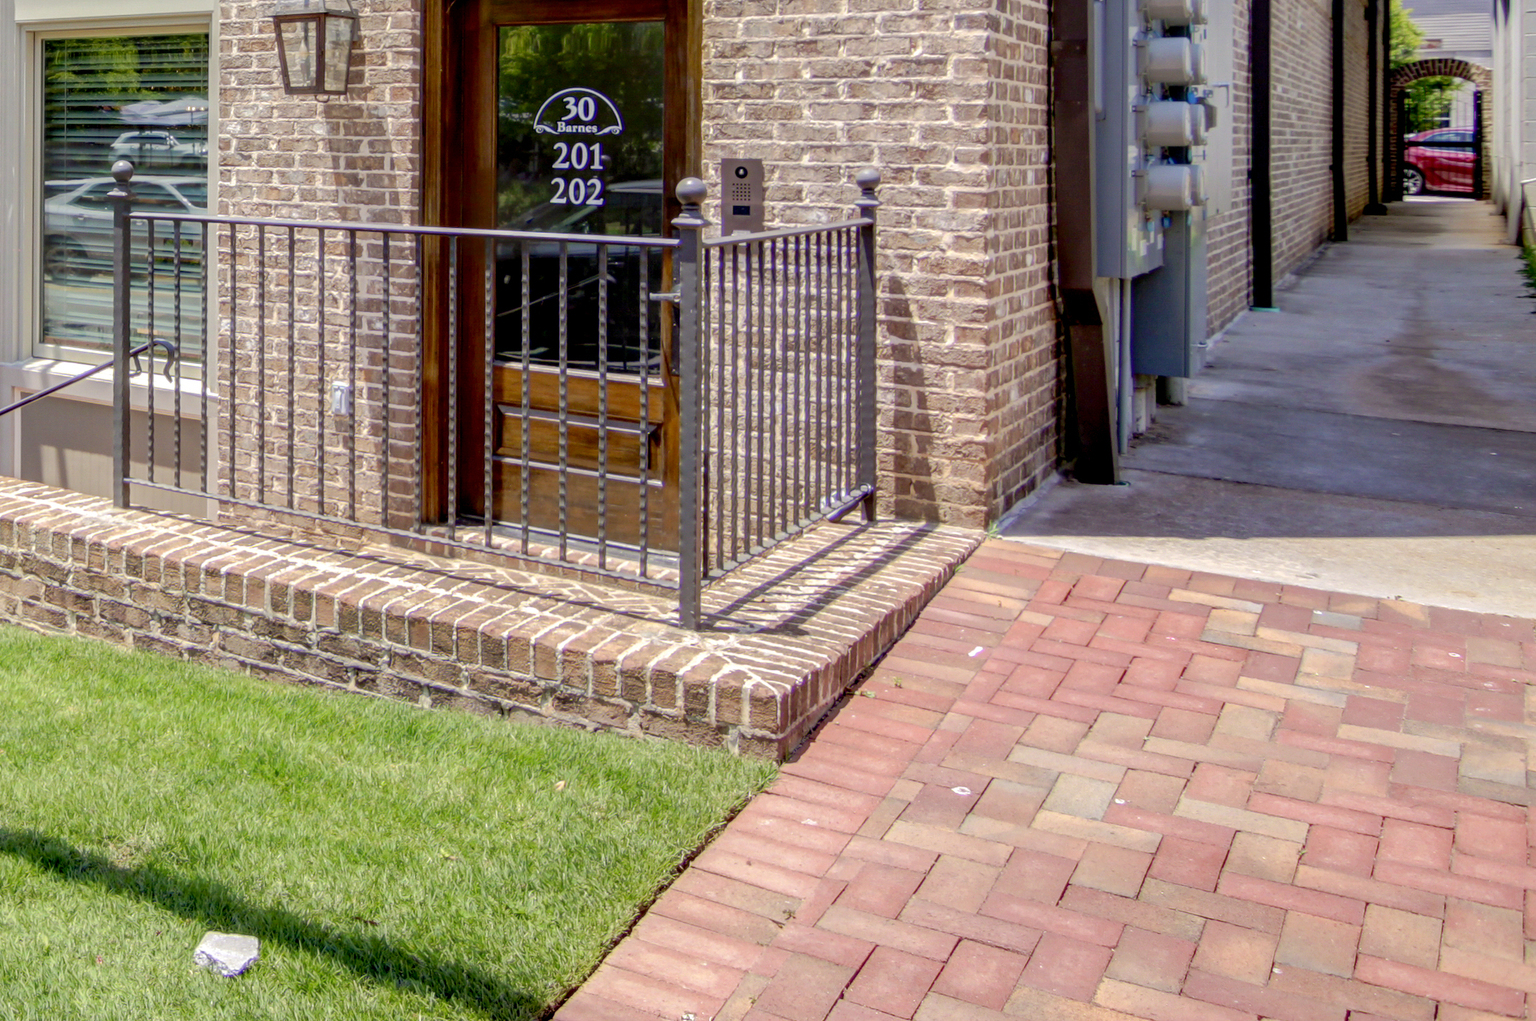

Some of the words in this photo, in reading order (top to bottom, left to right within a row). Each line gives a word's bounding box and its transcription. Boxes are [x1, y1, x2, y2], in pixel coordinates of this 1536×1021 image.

[561, 96, 595, 122] 30
[557, 121, 598, 133] Barnes
[552, 142, 603, 170] 201
[549, 177, 604, 205] 202
